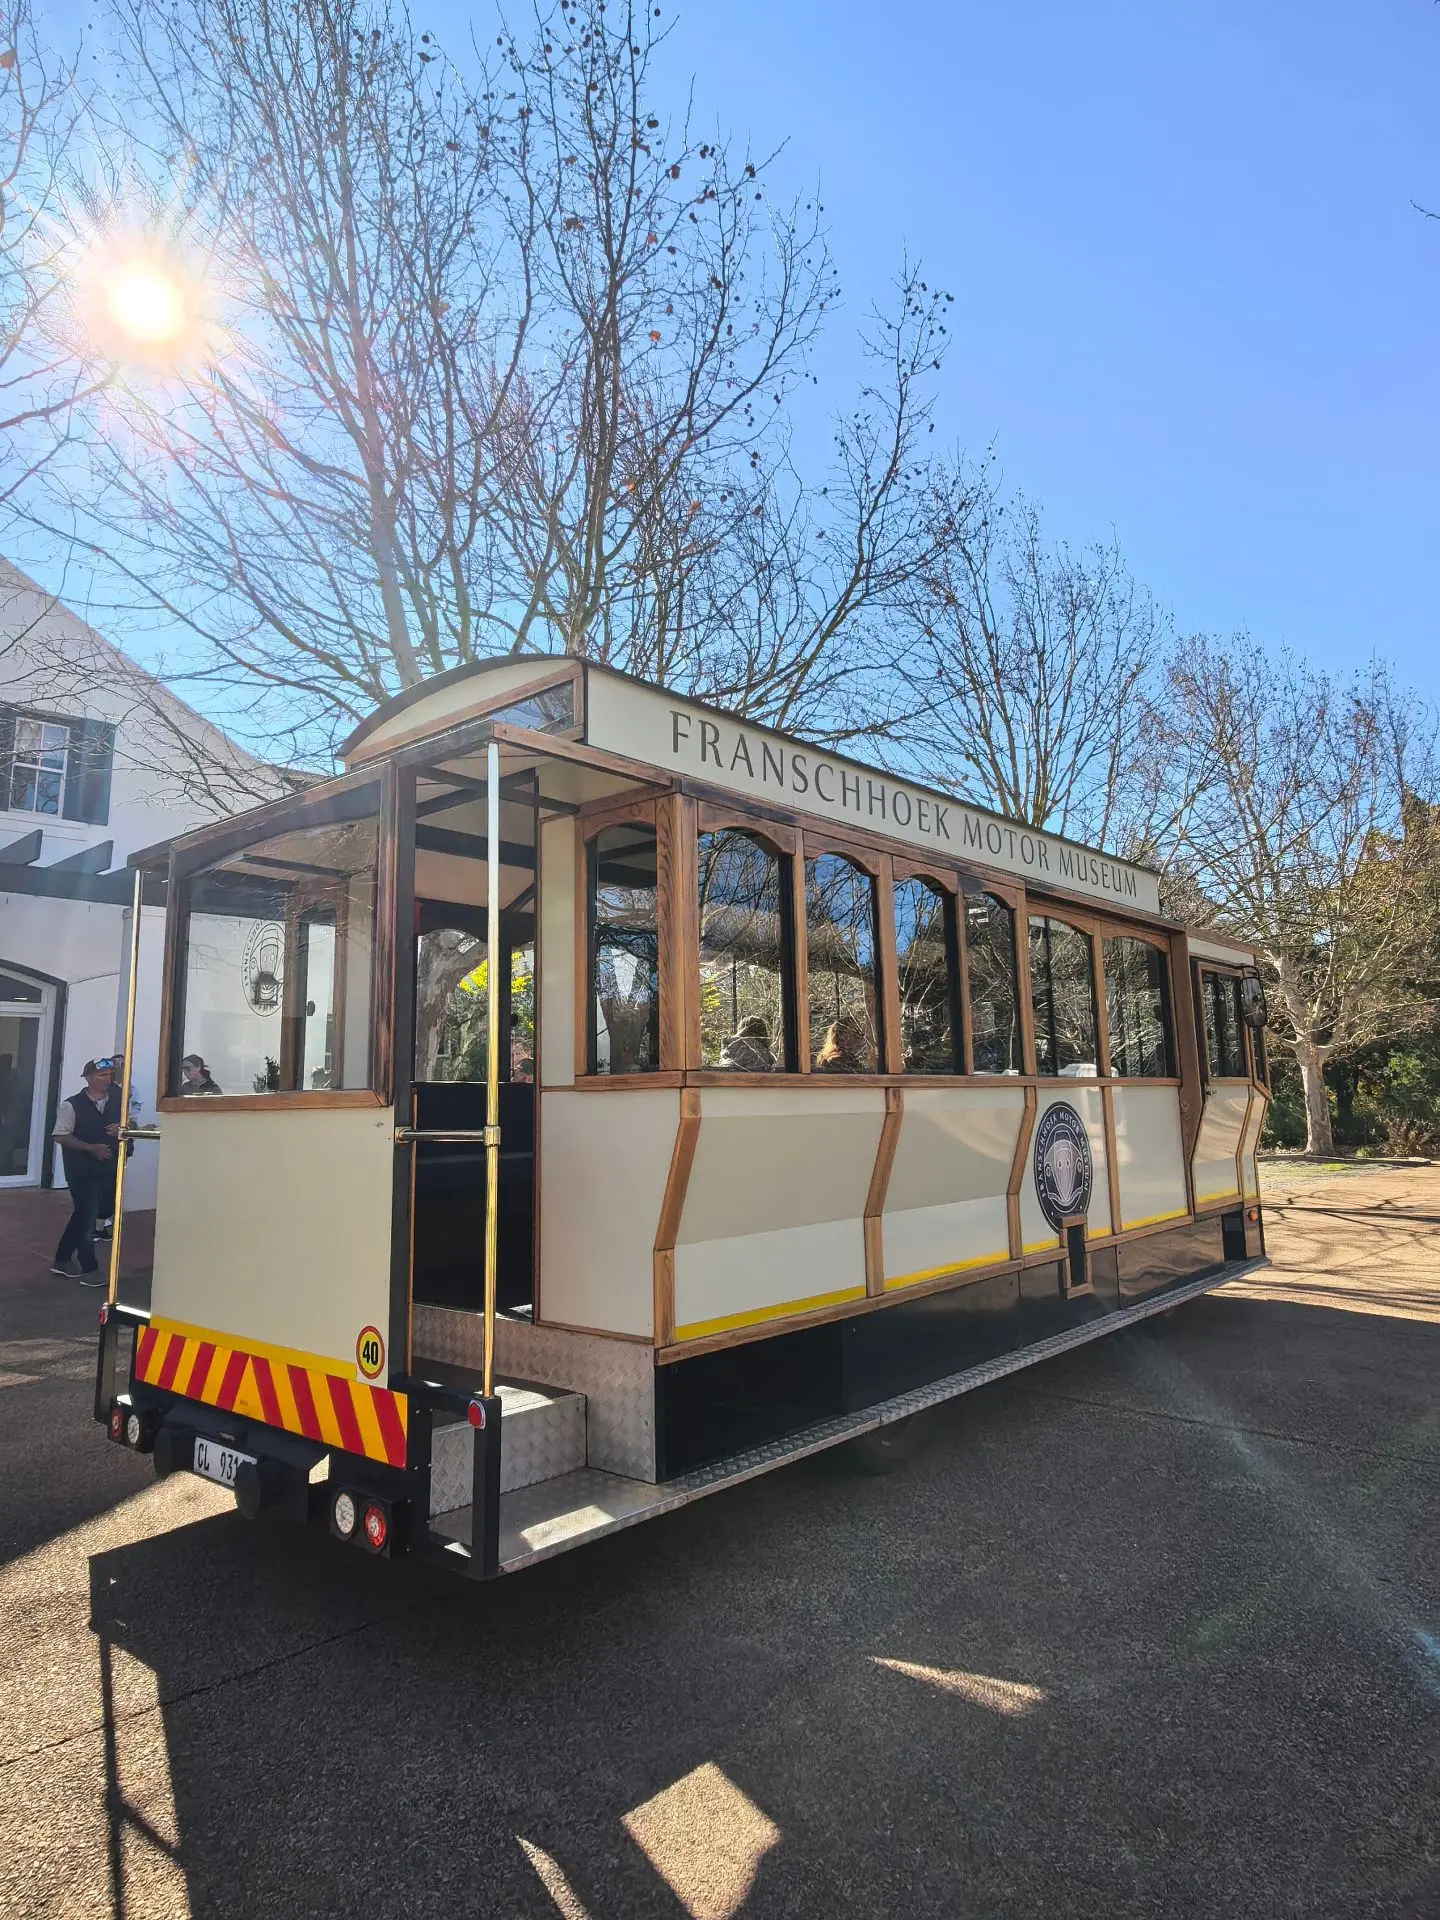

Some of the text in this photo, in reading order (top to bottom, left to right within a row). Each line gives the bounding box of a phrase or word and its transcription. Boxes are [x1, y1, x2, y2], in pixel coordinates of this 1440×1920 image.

[670, 710, 1137, 898] FRANSCHHOEK MOTOR MUSEUM
[362, 1340, 379, 1366] 40
[197, 1443, 239, 1482] CL 931
